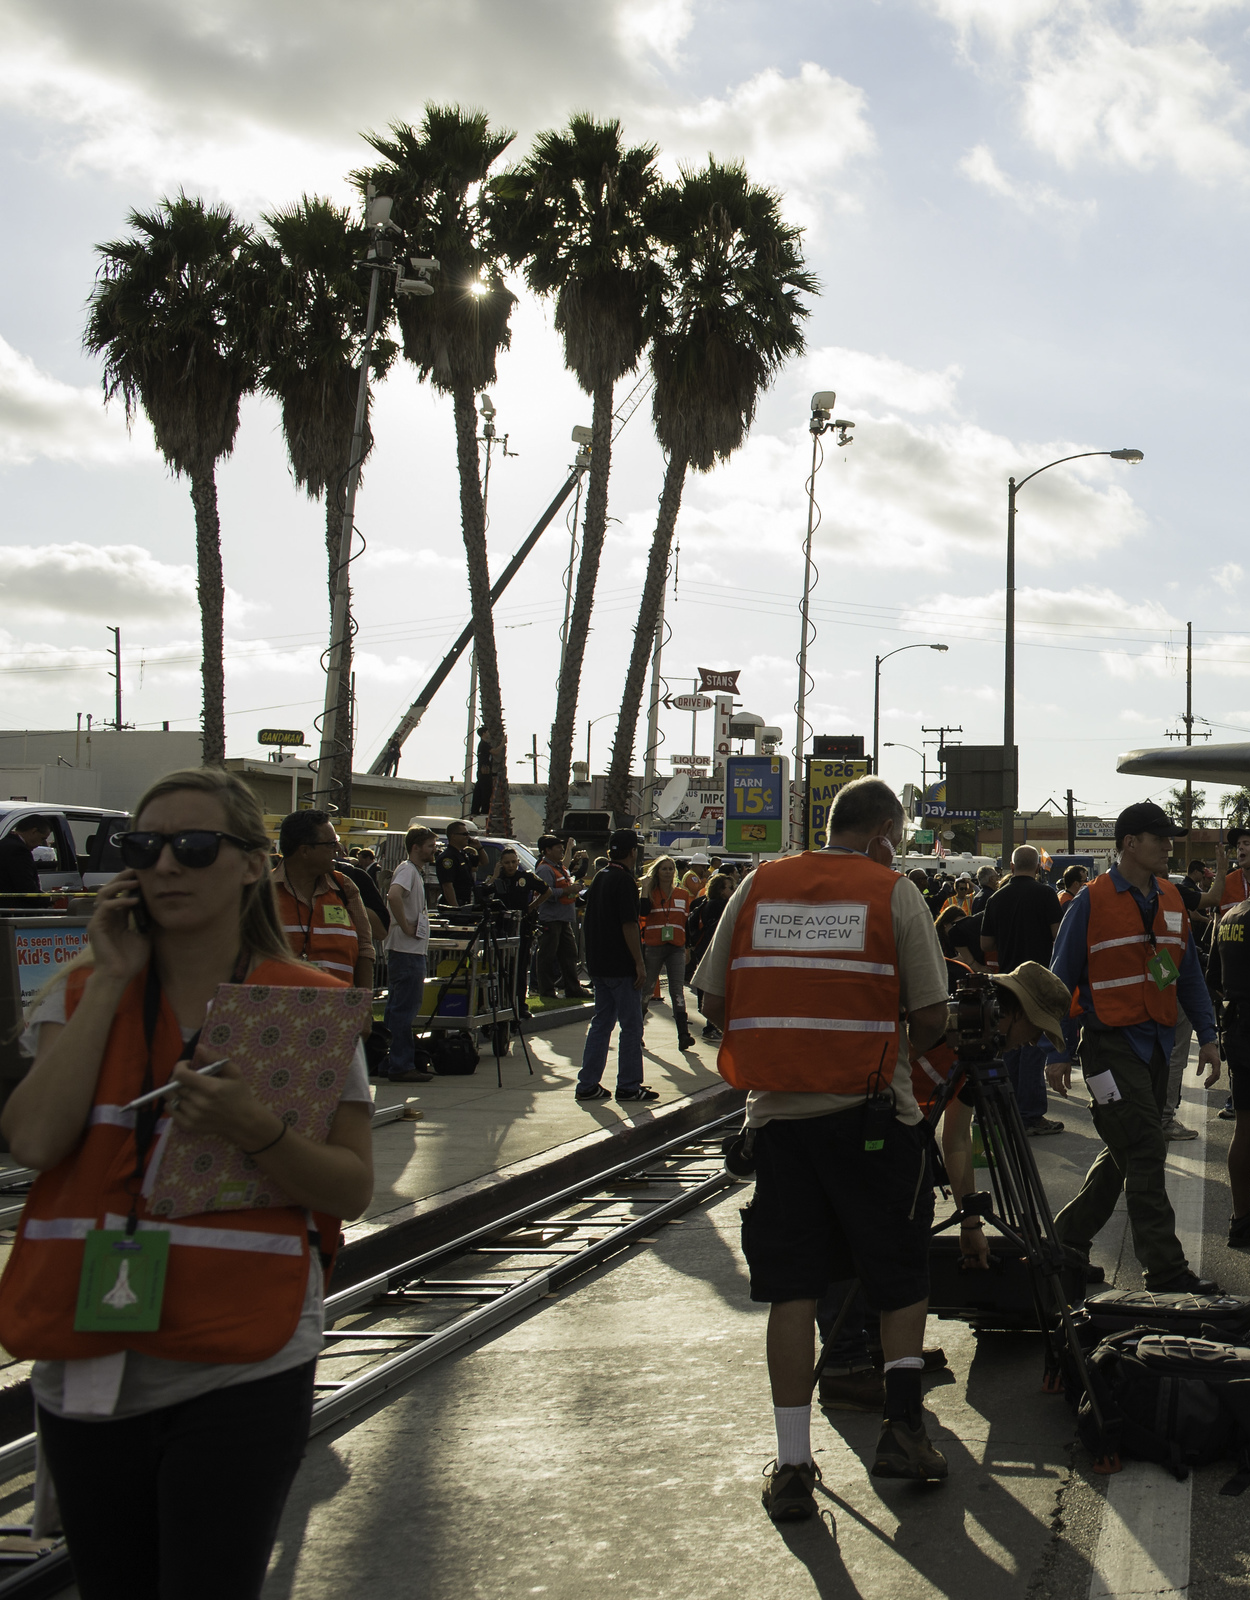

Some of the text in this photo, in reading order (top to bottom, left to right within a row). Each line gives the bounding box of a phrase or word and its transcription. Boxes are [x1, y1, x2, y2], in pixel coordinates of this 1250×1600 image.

[706, 674, 734, 687] STANS
[678, 697, 711, 708] DRIVE IN
[261, 732, 302, 744] SANDMAN
[673, 756, 710, 765] LIQUOR
[733, 778, 763, 787] EARN
[759, 914, 861, 926] ENDEAVOUR
[764, 928, 852, 940] FILM CREW
[1217, 923, 1245, 943] POLICE
[16, 936, 29, 947] As
[30, 936, 53, 947] seen
[54, 934, 63, 945] in
[65, 934, 80, 945] the
[17, 948, 51, 966] Kid's
